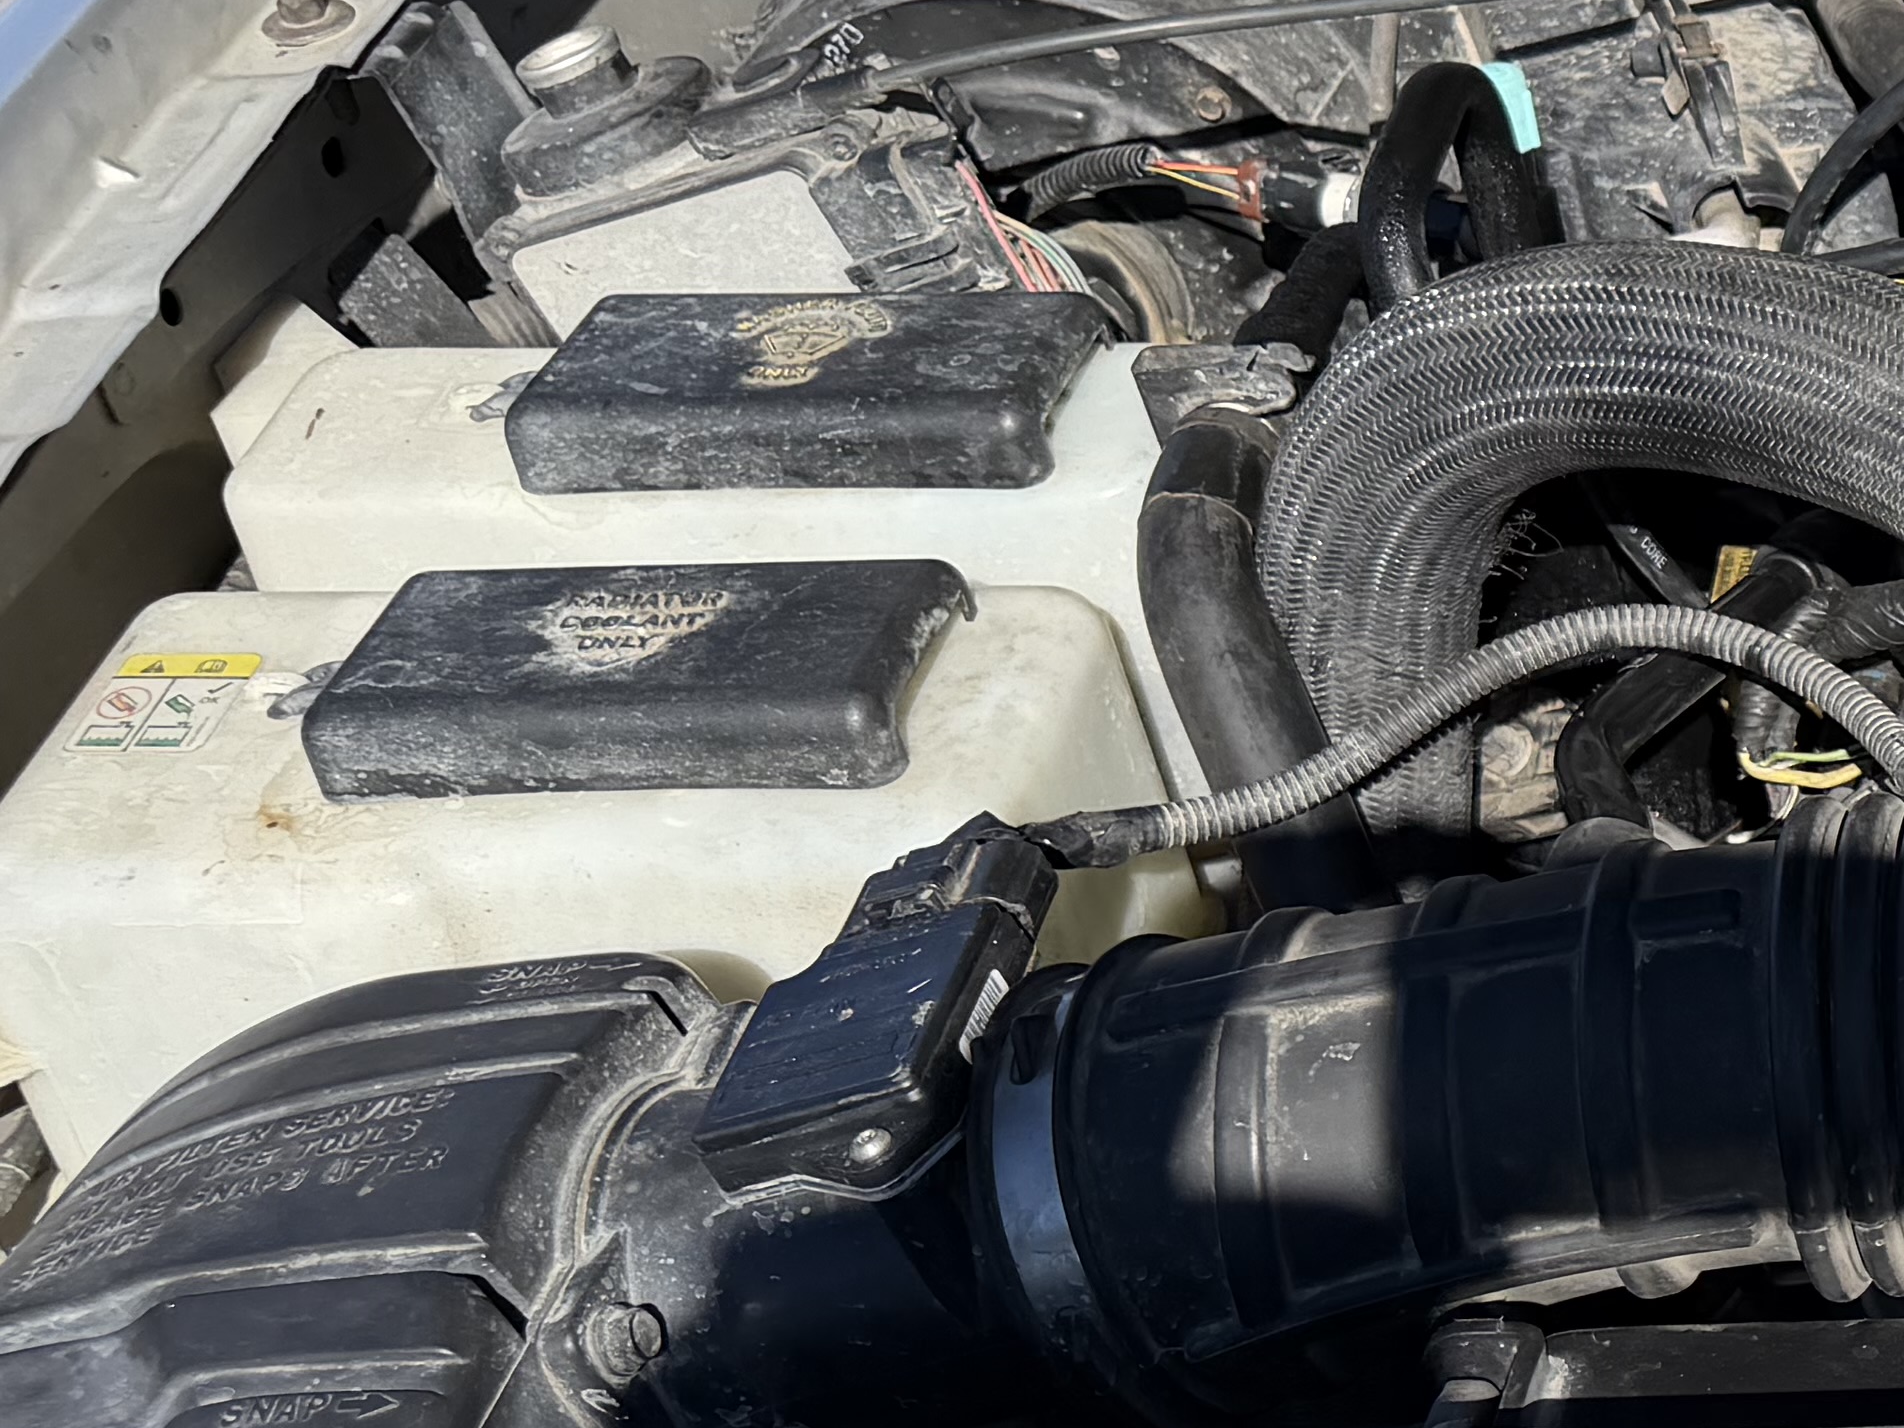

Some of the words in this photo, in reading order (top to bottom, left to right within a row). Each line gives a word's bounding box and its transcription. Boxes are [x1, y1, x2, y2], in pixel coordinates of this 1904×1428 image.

[1641, 537, 1668, 569] CORE
[566, 592, 725, 608] RADIATOR
[560, 614, 705, 630] COOLANT
[578, 636, 651, 651] ONLY
[219, 1394, 332, 1428] SNAP
